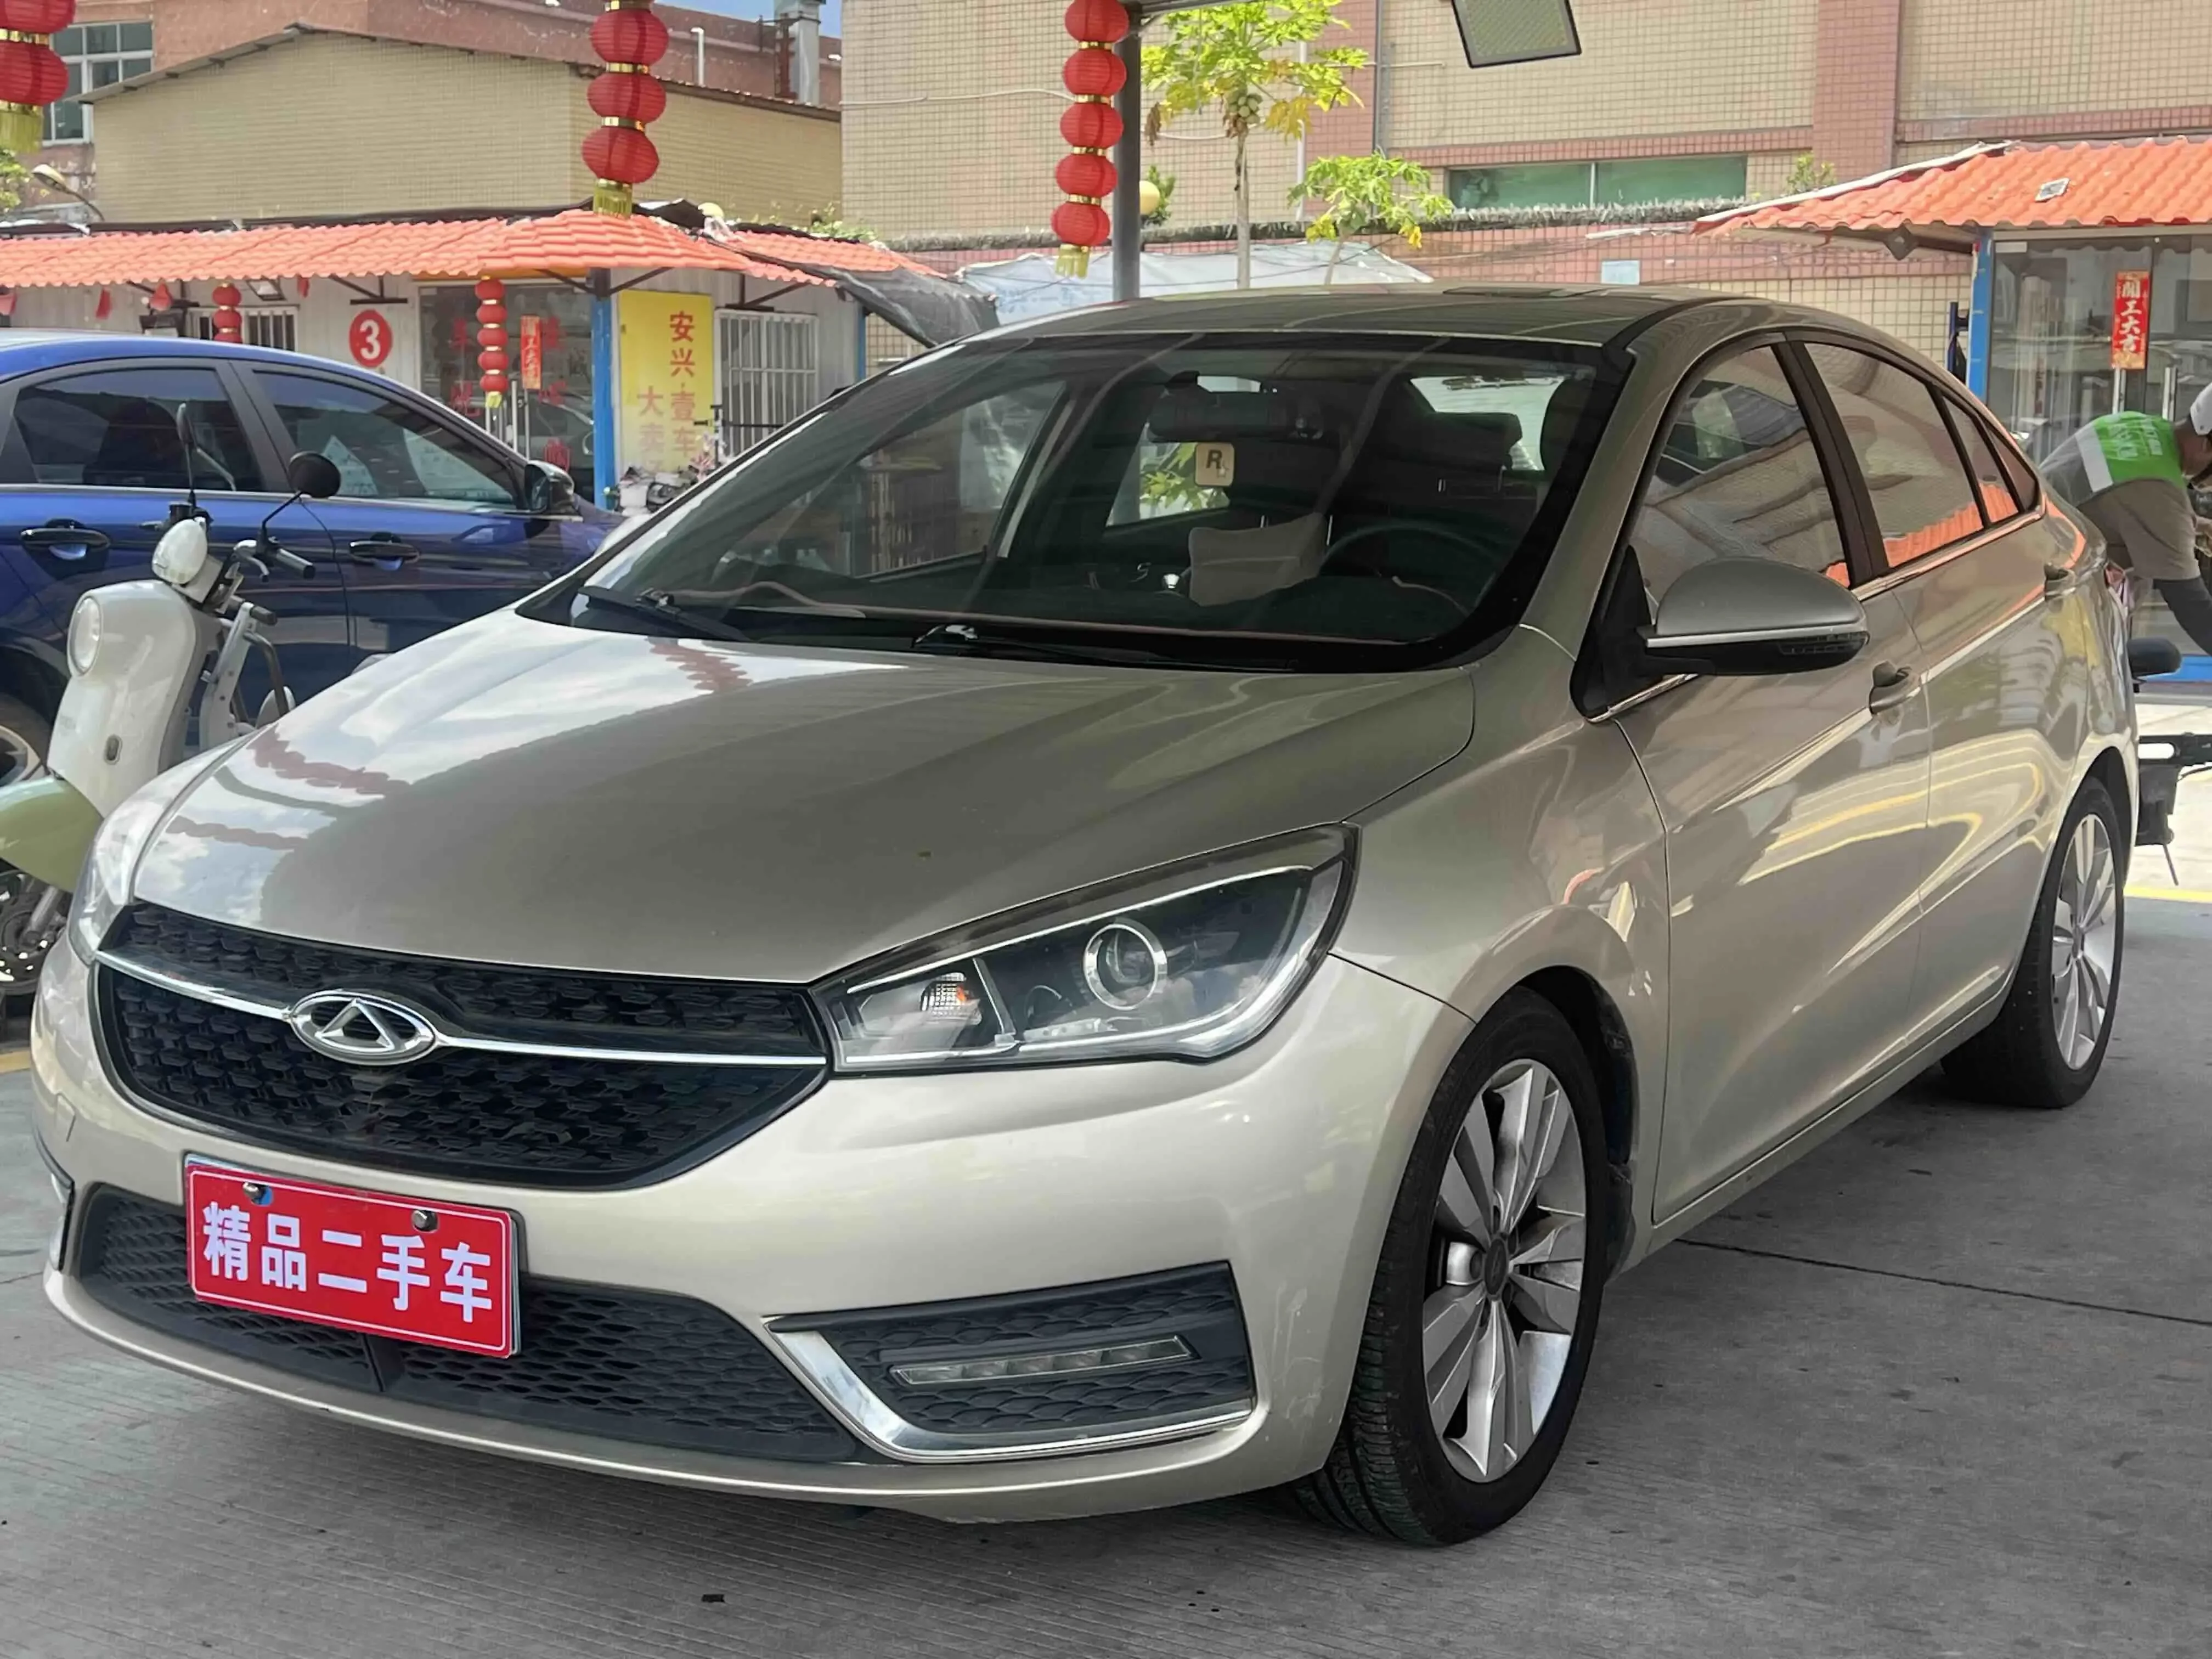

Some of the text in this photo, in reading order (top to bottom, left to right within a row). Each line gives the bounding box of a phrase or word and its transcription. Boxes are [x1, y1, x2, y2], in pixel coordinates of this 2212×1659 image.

[359, 319, 381, 360] 3
[1206, 449, 1222, 469] R
[202, 1201, 492, 1323] 精品二手车
